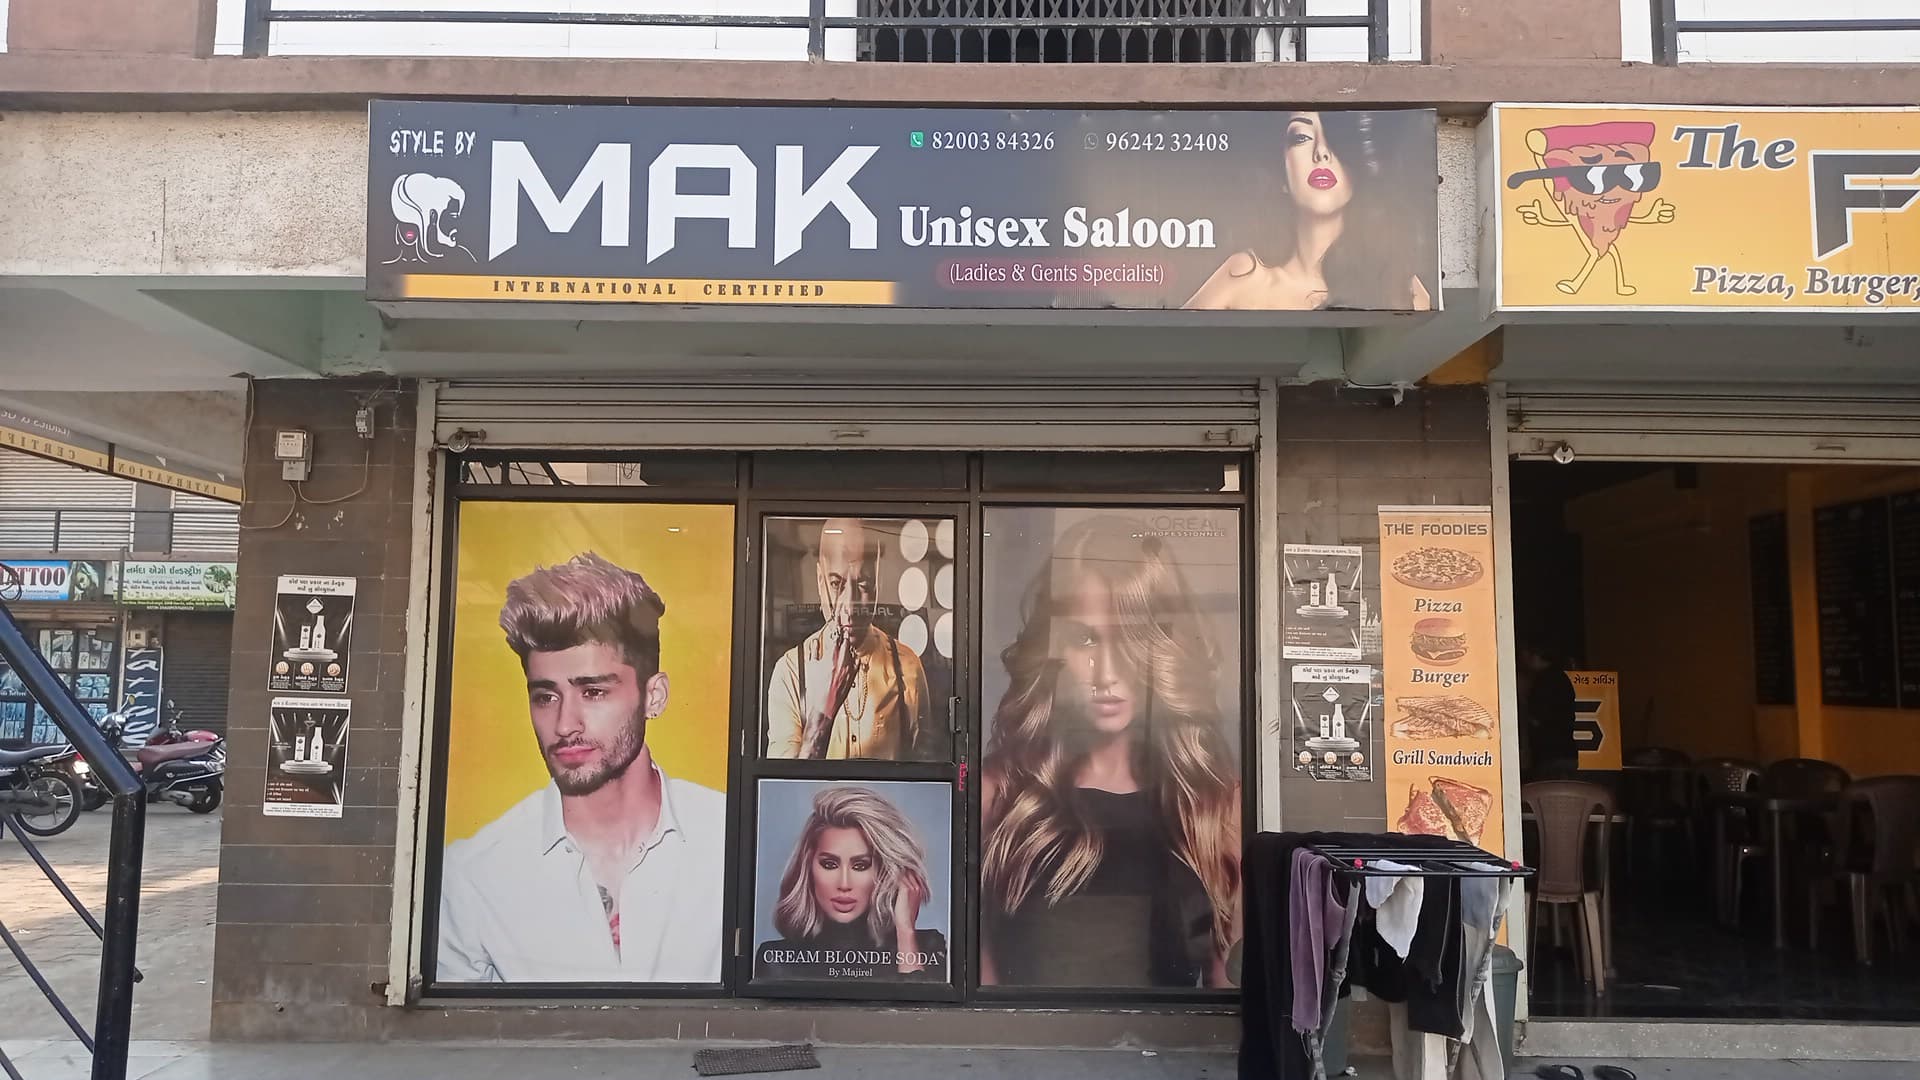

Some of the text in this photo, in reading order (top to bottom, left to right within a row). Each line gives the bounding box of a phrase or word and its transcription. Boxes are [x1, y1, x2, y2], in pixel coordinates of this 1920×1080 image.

[390, 130, 476, 156] STYLE BY
[932, 131, 1054, 150] 82003 84326
[1106, 132, 1229, 151] 96242 32408
[1673, 125, 1795, 170] The
[489, 140, 880, 265] MAK
[900, 206, 1216, 248] Unisex Saloon
[949, 263, 1164, 285] (Ladies & Gents Specialist)
[1692, 267, 1795, 300] Pizza,
[493, 280, 825, 297] INTERNATIONAL CERTIFIED
[1384, 523, 1488, 536] THE FOODIES
[1414, 598, 1463, 613] Pizza
[1411, 668, 1469, 688] Burger
[1393, 750, 1492, 765] Grill Sandwich
[763, 950, 939, 966] CREAM BLONDE SODA
[828, 967, 873, 977] By Majirel
